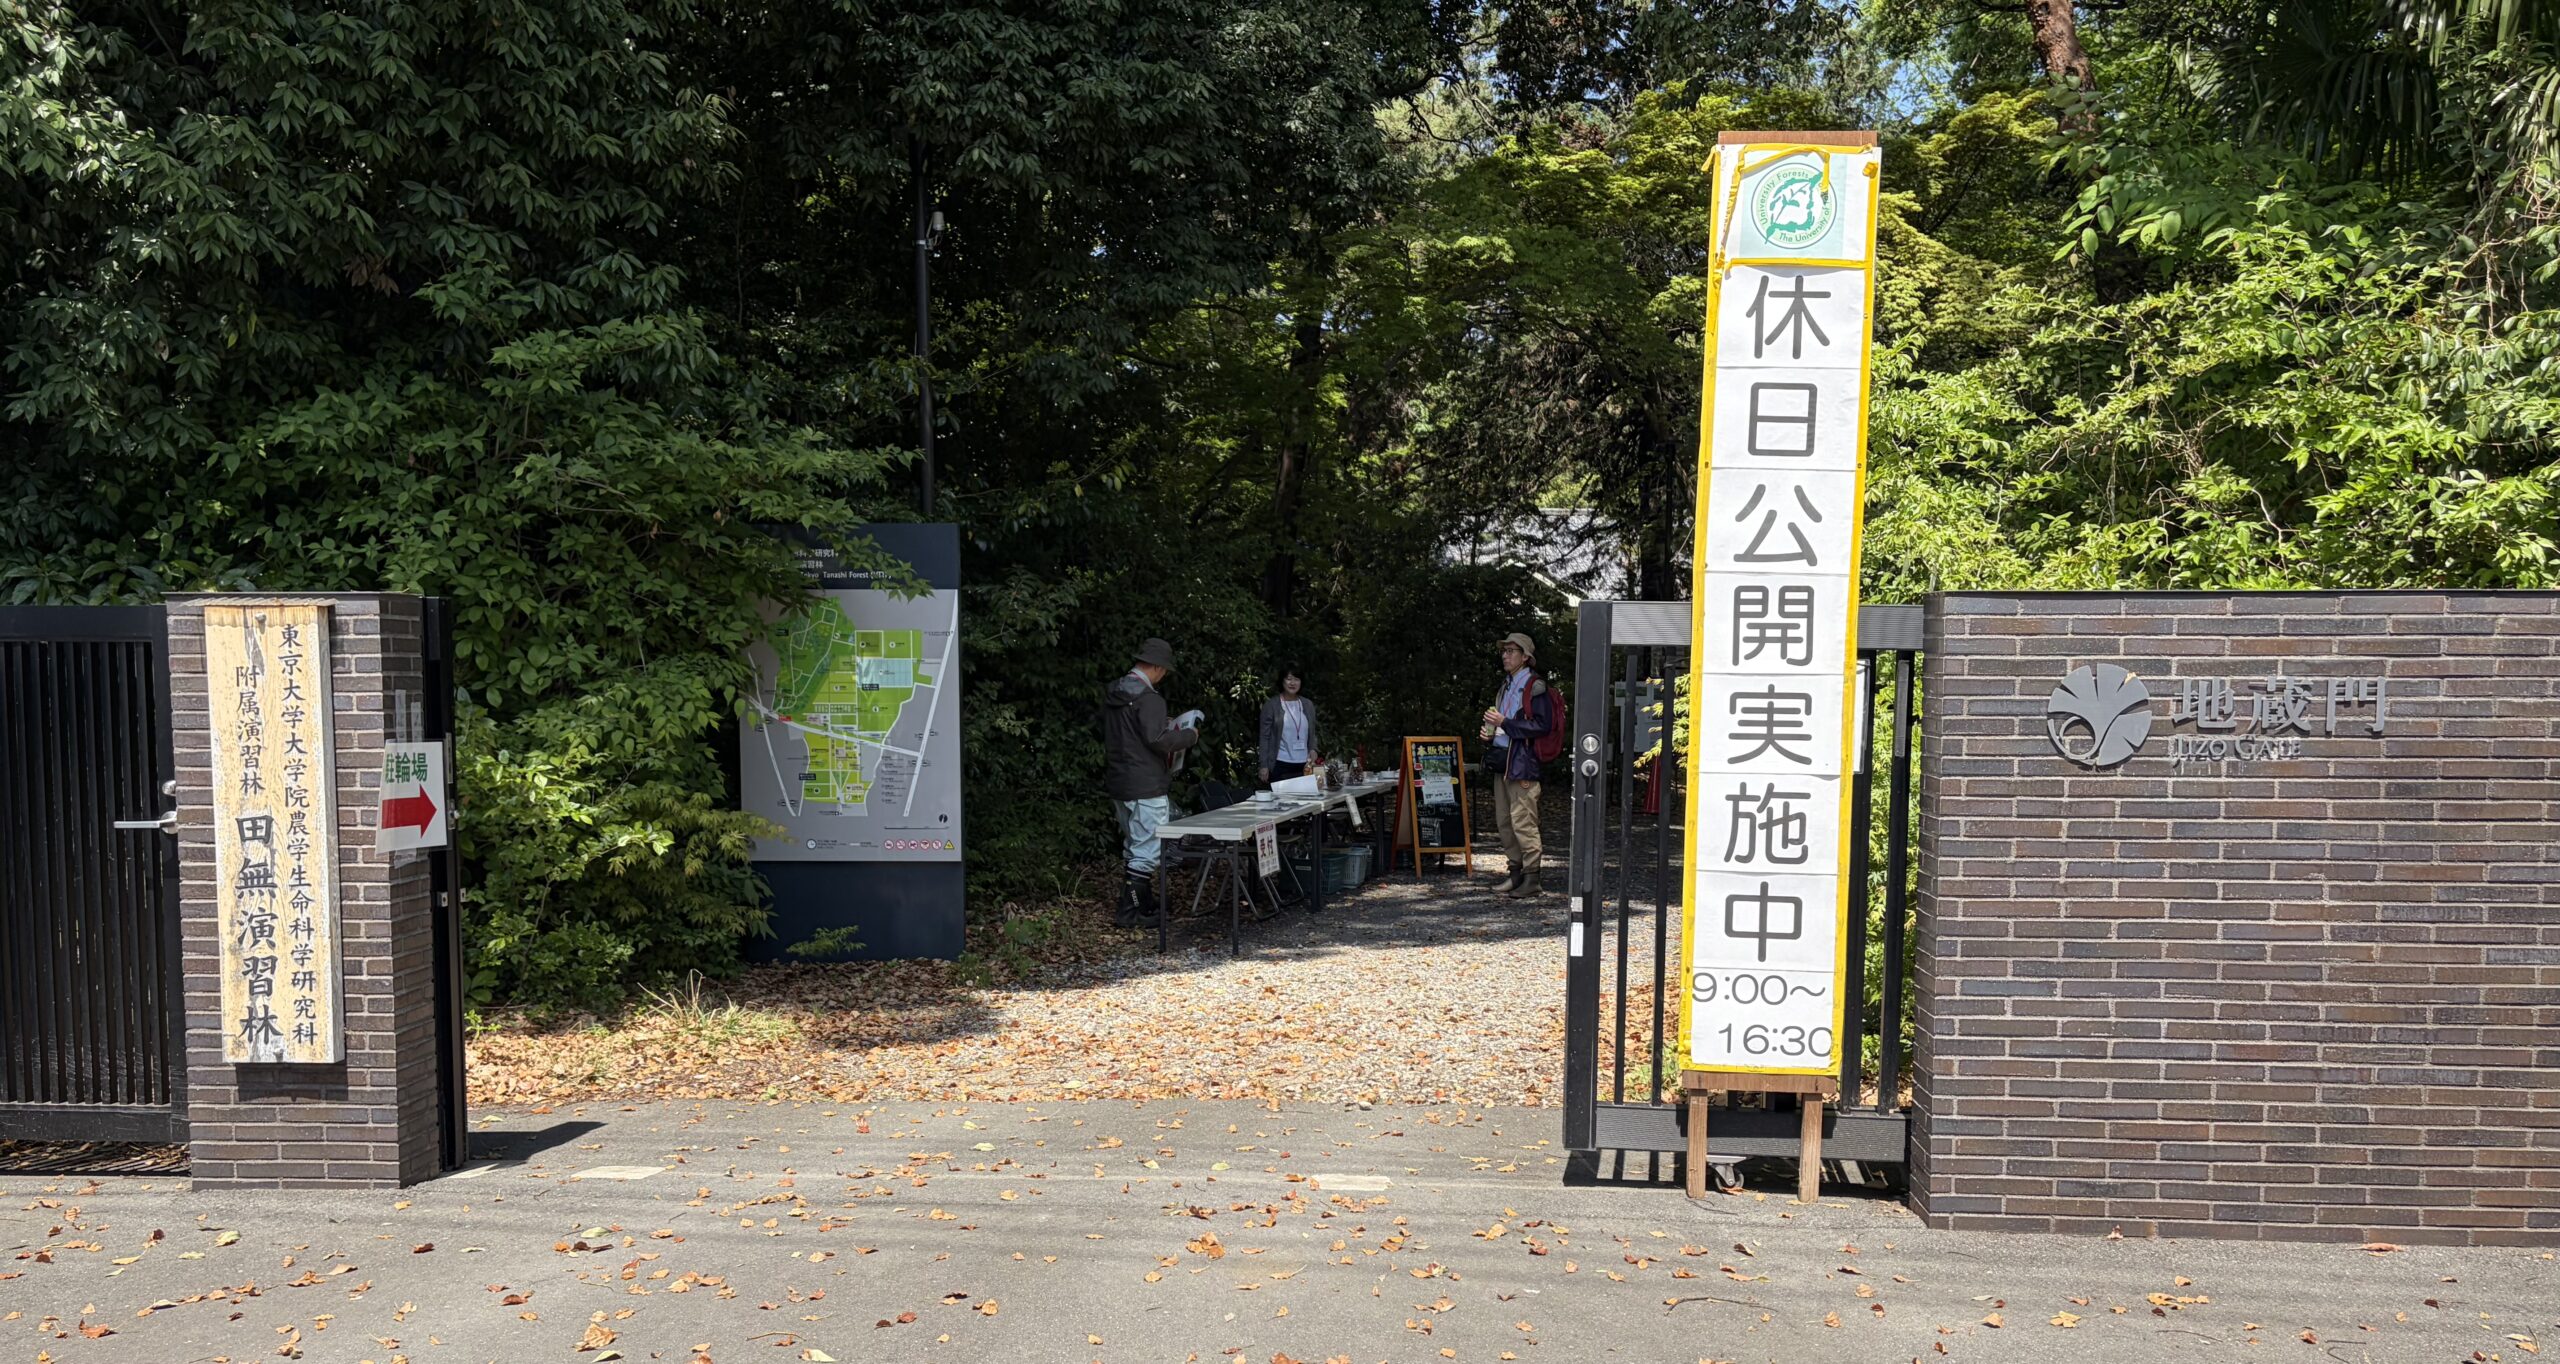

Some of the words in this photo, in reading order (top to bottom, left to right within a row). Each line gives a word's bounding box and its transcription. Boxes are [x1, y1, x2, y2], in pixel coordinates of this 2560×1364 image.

[1759, 181, 1776, 226] University
[1776, 170, 1809, 181] Forests
[1779, 232, 1793, 243] The
[1795, 218, 1829, 242] University
[823, 571, 847, 579] Tanashi
[849, 571, 869, 579] Forest
[1723, 275, 1832, 963] 休日公開実施中
[235, 664, 266, 796] 附属演習林
[2172, 675, 2386, 732] 地蔵門
[385, 752, 428, 784] 駐輪場
[2175, 735, 2227, 760] JIZO
[2234, 734, 2302, 756] GATE
[278, 623, 318, 1046] 東京大学大学院農学生命科学研究科
[234, 814, 284, 1045] 田無演習林
[1718, 1023, 1833, 1057] 16:30
